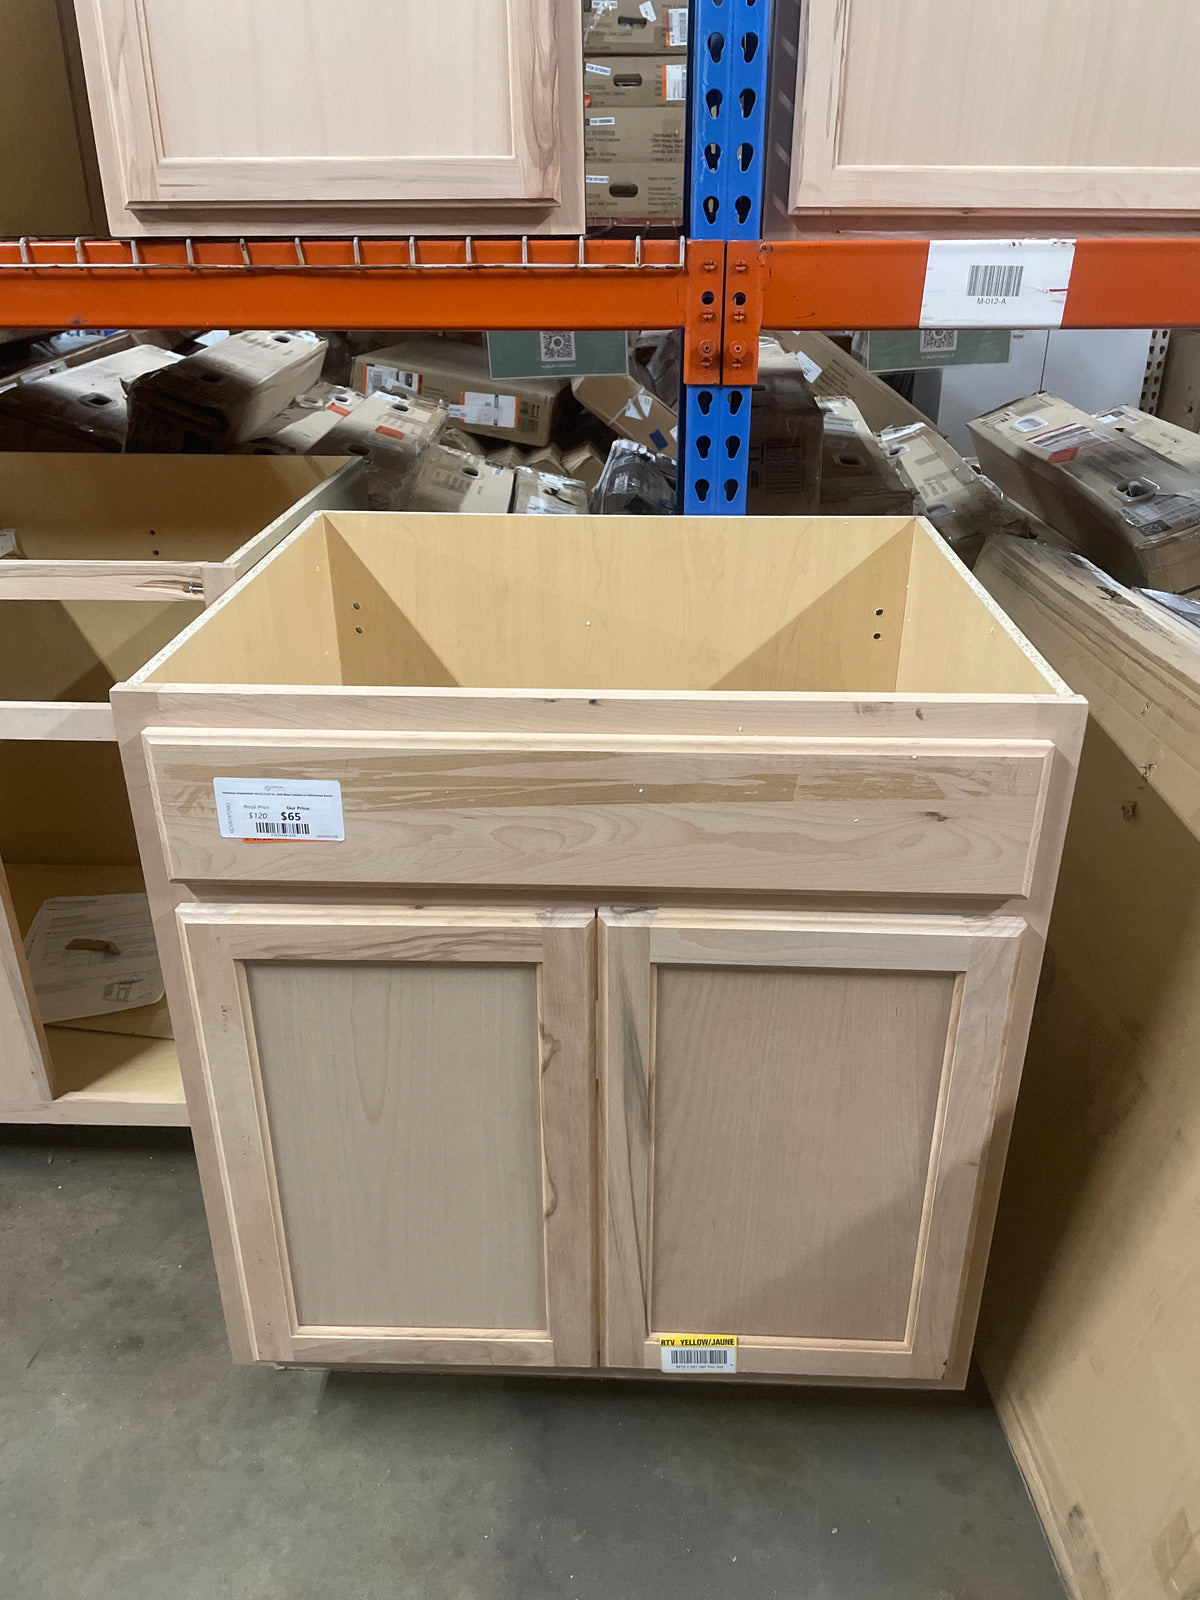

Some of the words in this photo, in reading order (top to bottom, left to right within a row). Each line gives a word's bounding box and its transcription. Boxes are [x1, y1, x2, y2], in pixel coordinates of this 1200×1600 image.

[248, 811, 268, 820] $120
[280, 812, 301, 821] $65
[681, 1338, 735, 1346] YELLOW/JAUNE
